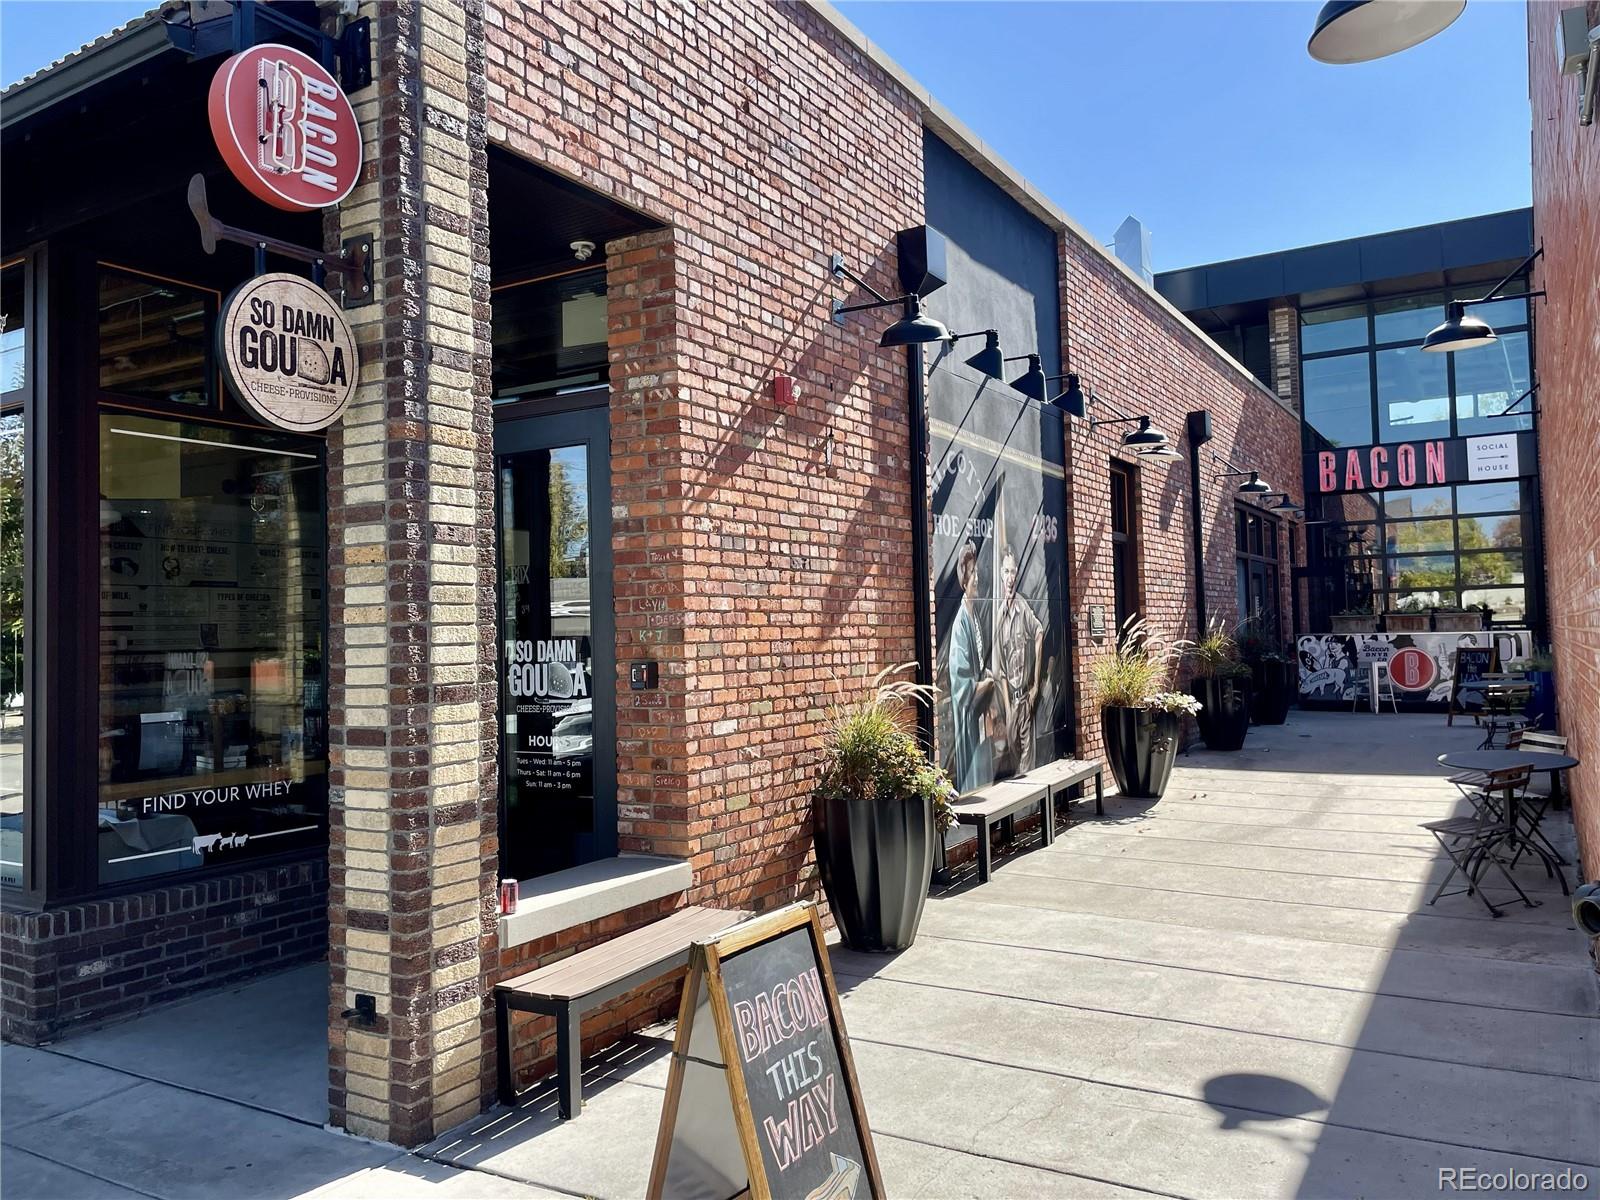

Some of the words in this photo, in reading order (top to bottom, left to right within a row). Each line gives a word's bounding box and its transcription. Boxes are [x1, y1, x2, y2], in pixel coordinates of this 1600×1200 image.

[301, 74, 338, 192] BACON
[250, 297, 276, 328] SO
[282, 305, 334, 343] DAMN
[1318, 441, 1446, 493] BACON
[1476, 443, 1509, 451] SOCIAL
[1477, 464, 1509, 472] HOUSE
[516, 640, 533, 662] SO
[537, 640, 576, 662] DAMN
[143, 793, 186, 814] FIND
[192, 786, 240, 807] YOUR
[245, 780, 292, 800] WHEY
[733, 966, 829, 1063] BACON
[766, 1040, 823, 1102] THIS
[763, 1073, 839, 1172] WAY
